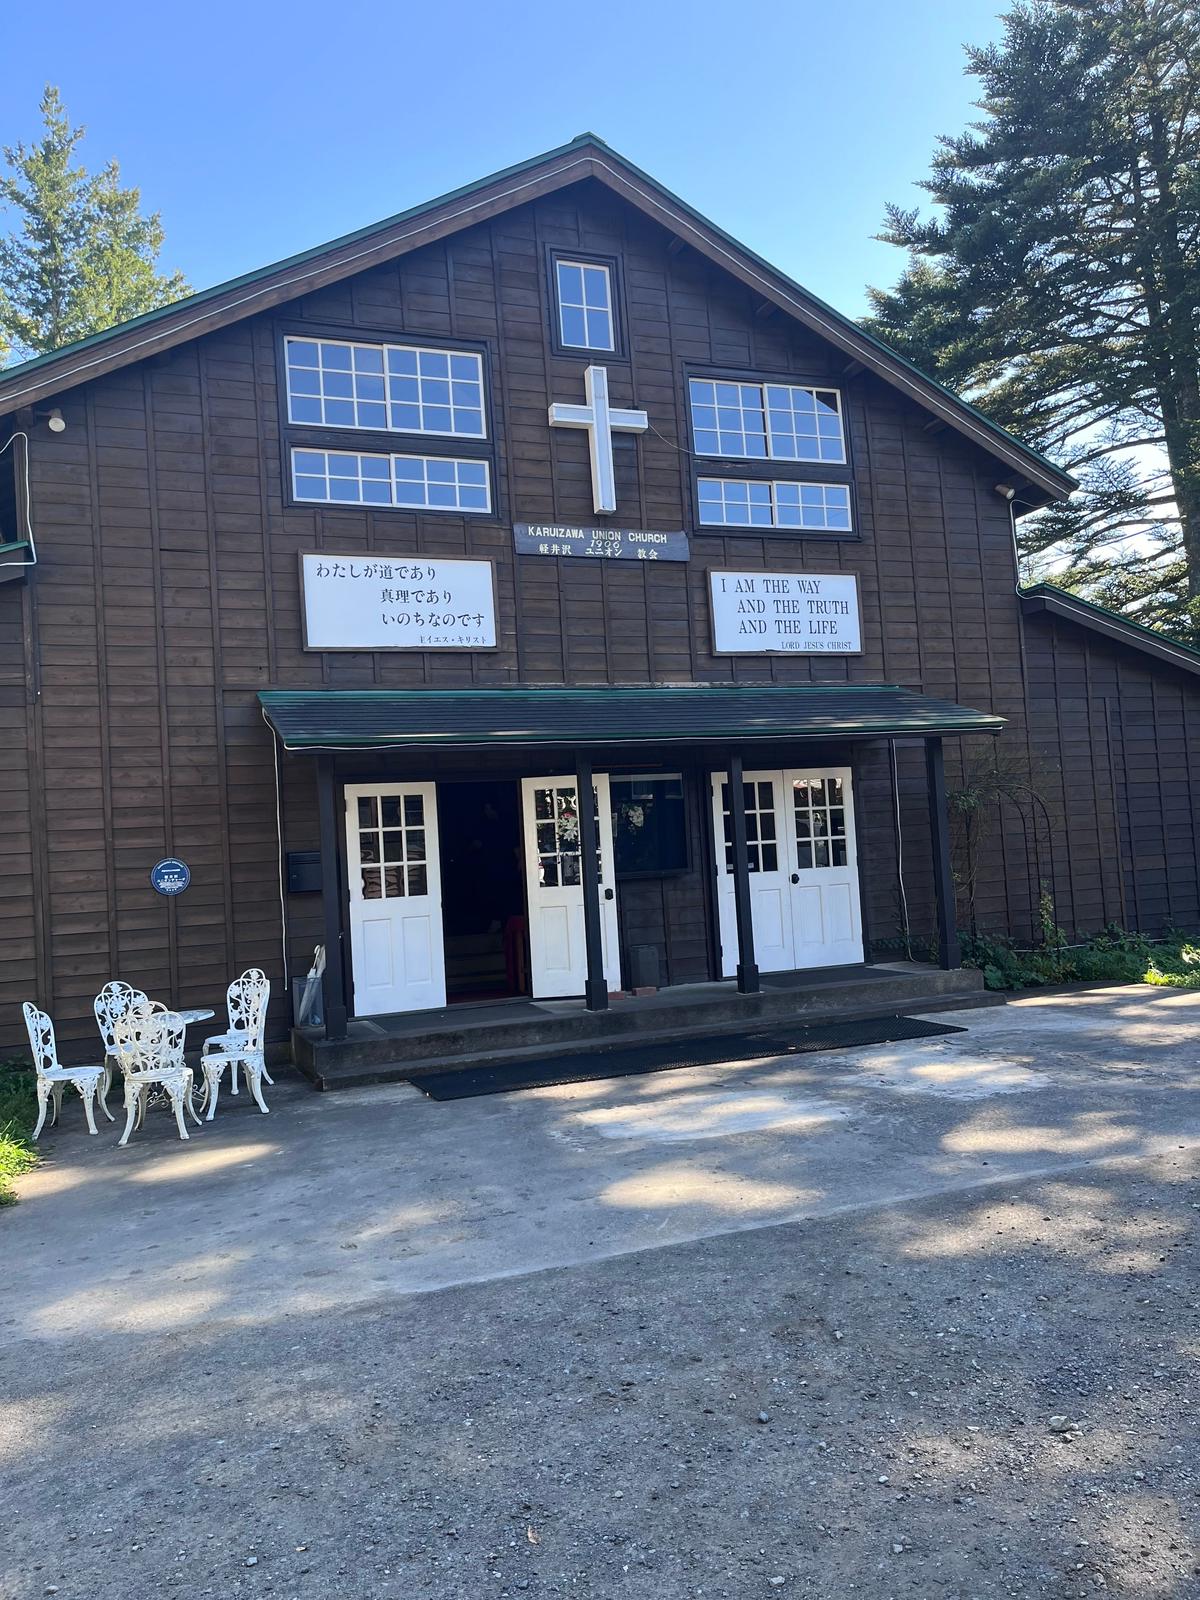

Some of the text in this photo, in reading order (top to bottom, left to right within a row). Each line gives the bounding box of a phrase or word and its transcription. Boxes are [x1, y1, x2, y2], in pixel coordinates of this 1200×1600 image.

[528, 526, 667, 544] KARUIZAWA UNION CHURCH
[539, 544, 658, 559] 軽井沢 ユニオン 教会
[590, 540, 620, 548] 1906
[316, 563, 436, 580] わたしが道であり
[721, 579, 821, 594] I AM THE WAY
[380, 588, 452, 604] 真理であり
[737, 600, 849, 614] AND THE TRUTH
[382, 612, 485, 627] いのちなのです
[739, 620, 838, 634] AND THE LIFE
[781, 642, 852, 650] LORD JESUS CHRIST
